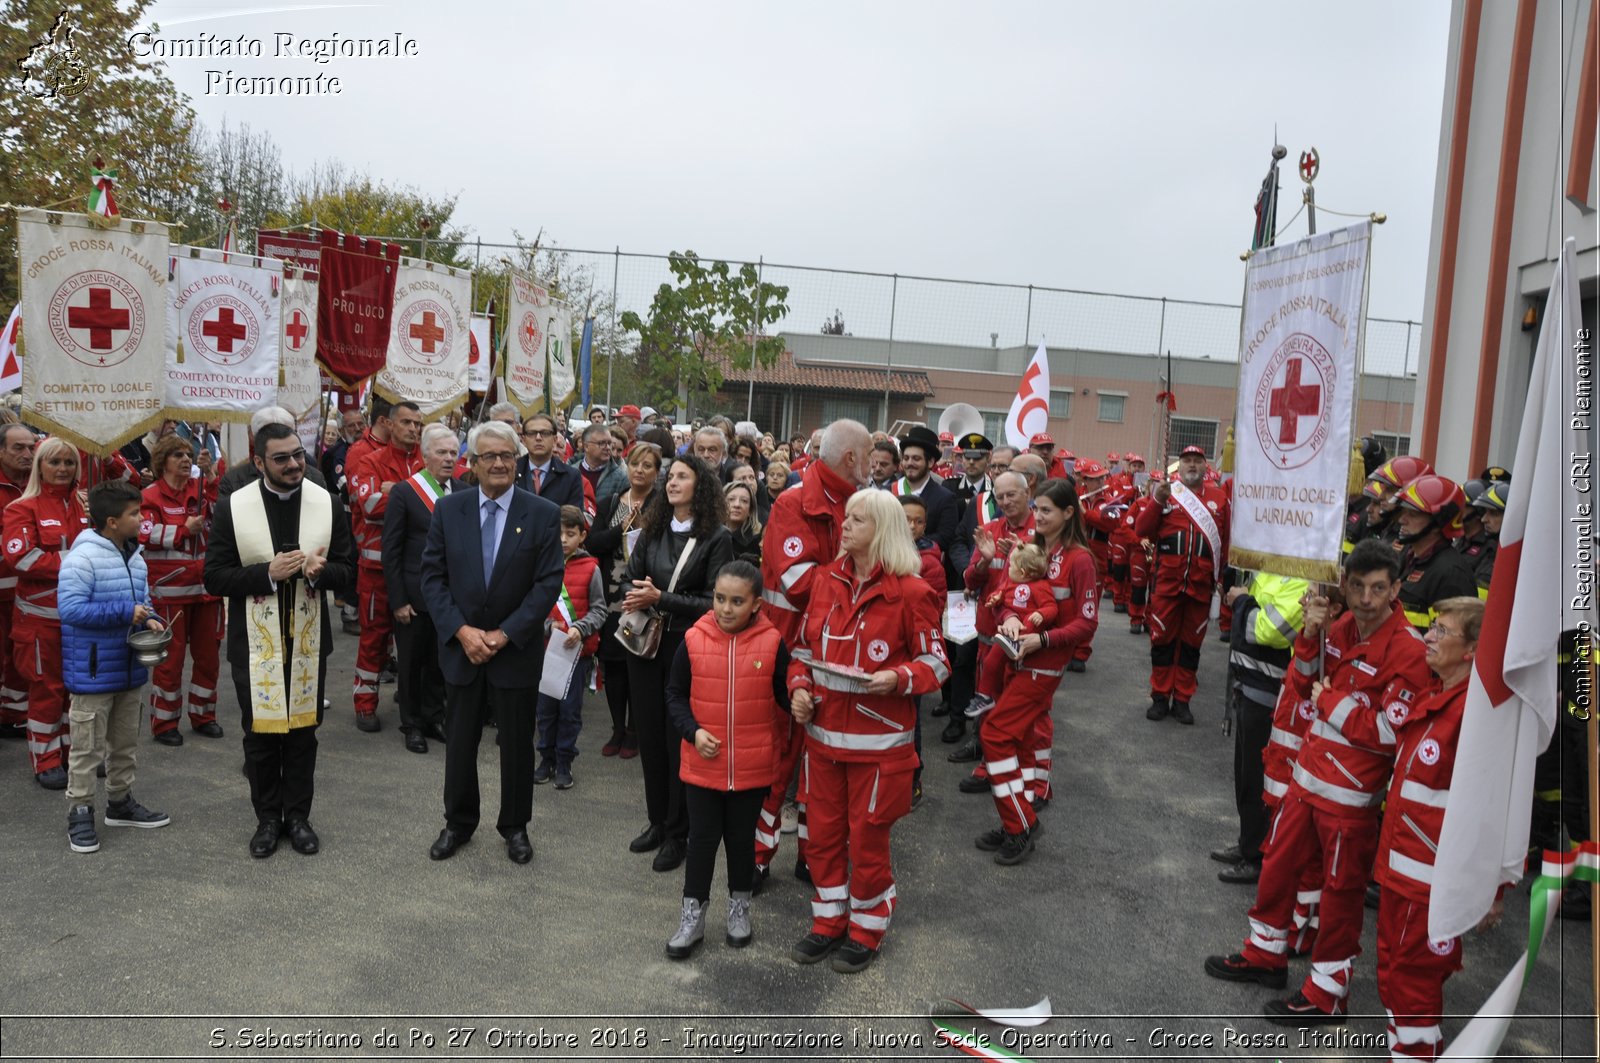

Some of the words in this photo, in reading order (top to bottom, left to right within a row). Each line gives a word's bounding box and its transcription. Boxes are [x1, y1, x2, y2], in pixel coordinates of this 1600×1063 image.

[27, 246, 67, 279] CROCE
[70, 239, 115, 253] ROSSA
[121, 245, 166, 288] ITALIANA
[68, 277, 80, 289] DI
[79, 273, 122, 289] GINEVRA
[121, 284, 133, 296] 22
[408, 281, 440, 292] ROSSA
[173, 282, 202, 310] CROCE
[203, 275, 236, 287] ROSSA
[238, 280, 272, 320] ITALIANA
[129, 292, 144, 336] AGOSTO
[332, 298, 355, 314] PRO
[359, 304, 385, 320] LOCO
[51, 284, 77, 353] CONVENZIONE
[354, 323, 364, 334] DI
[1244, 312, 1279, 364] CROCE
[1280, 295, 1313, 320] ROSSA
[123, 337, 139, 355] 1864
[1284, 337, 1314, 355] GINEVRA
[1313, 350, 1327, 366] 22
[168, 370, 224, 383] COMITATO
[226, 376, 261, 387] LOCALE
[263, 378, 274, 386] DI
[394, 365, 433, 376] COMITATO
[434, 369, 455, 380] LOCALE
[43, 383, 106, 394] COMITATO
[110, 381, 153, 392] LOCALE
[182, 385, 262, 401] CRESCENTINO
[382, 371, 424, 399] GASSINO
[428, 381, 465, 400] TORINESE
[1323, 365, 1336, 423] AGOSTO
[35, 401, 95, 413] SETTIMO
[103, 398, 161, 411] TORINESE
[1257, 365, 1276, 450] CONVENZIONE
[1310, 426, 1326, 451] 1864
[1238, 484, 1287, 501] COMITATO
[1292, 487, 1336, 505] LOCALE
[1255, 507, 1313, 528] LAURIANO
